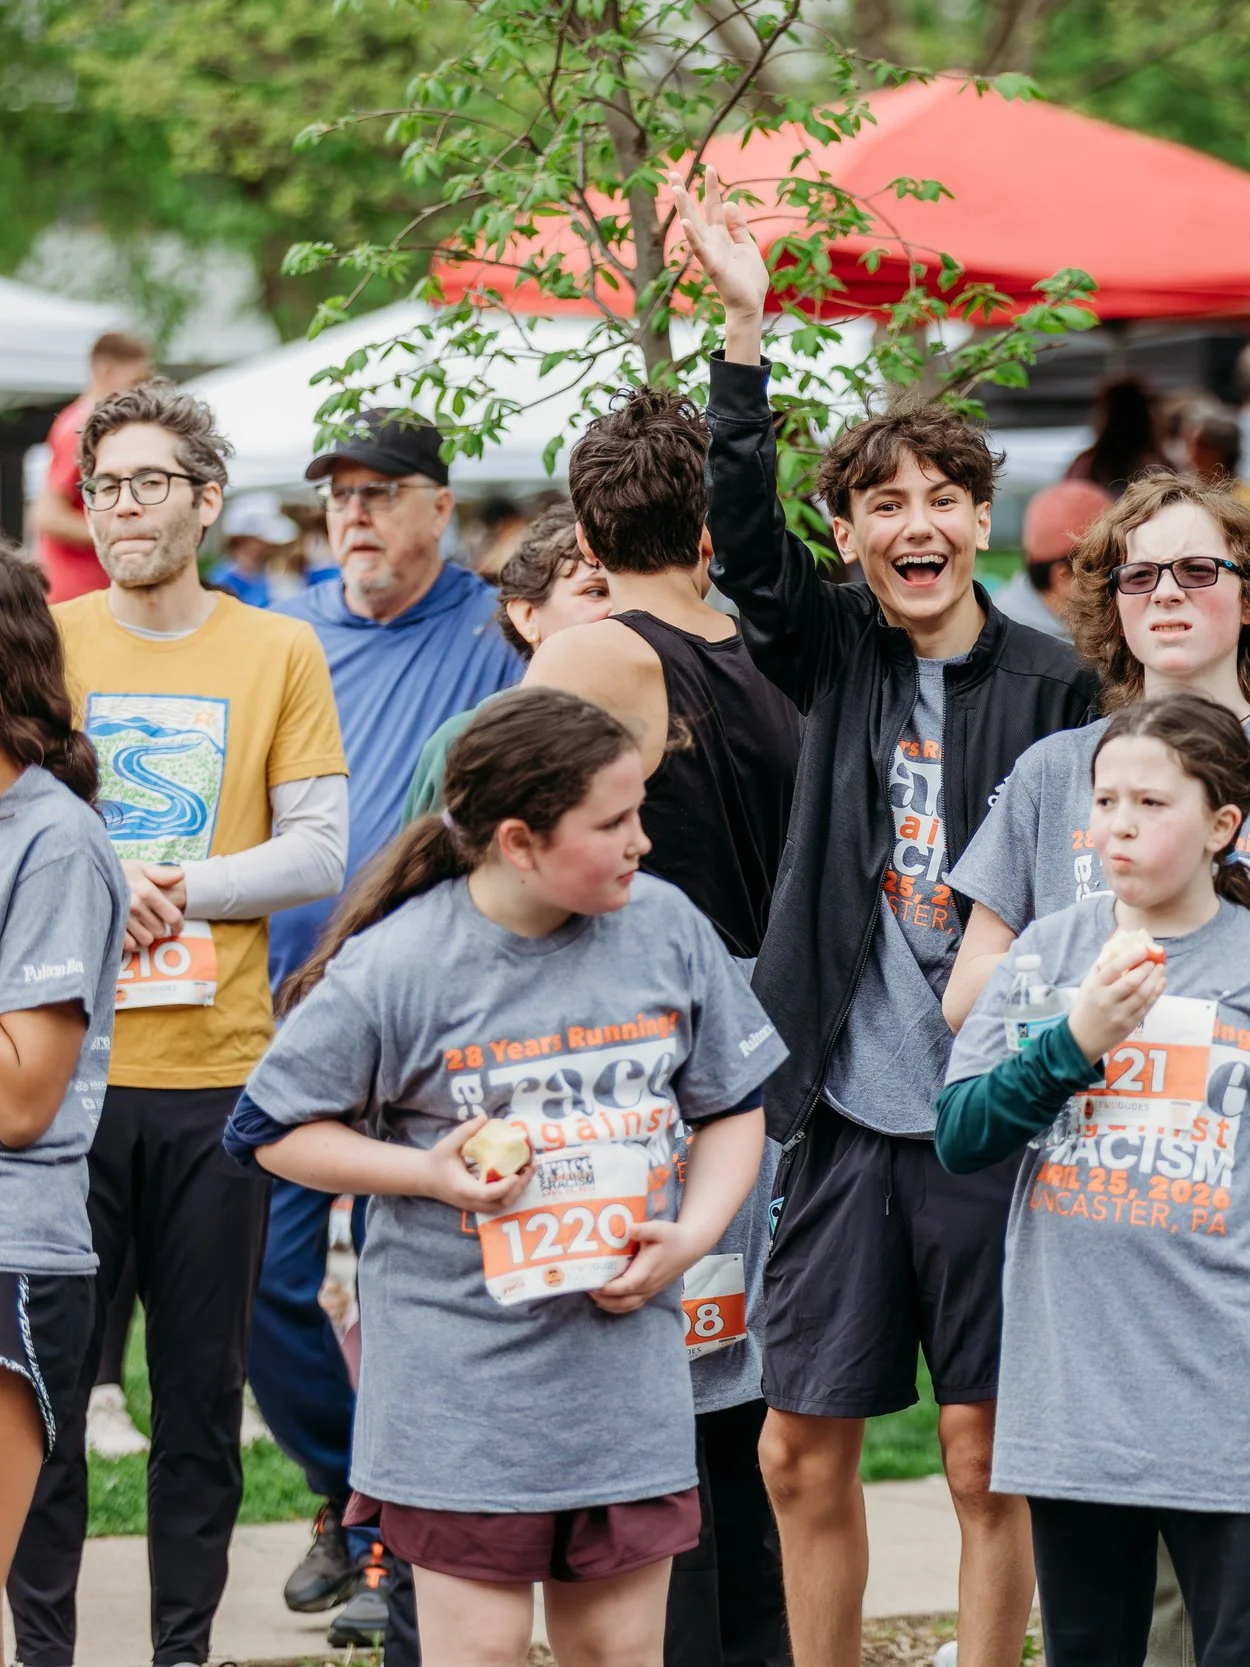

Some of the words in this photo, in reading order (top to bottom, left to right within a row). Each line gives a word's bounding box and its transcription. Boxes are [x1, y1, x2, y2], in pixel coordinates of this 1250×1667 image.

[443, 1044, 484, 1071] 28
[1087, 1167, 1138, 1201] 25,
[1148, 1175, 1231, 1211] 2026
[502, 1203, 635, 1265] 1220
[1190, 1208, 1227, 1238] PA
